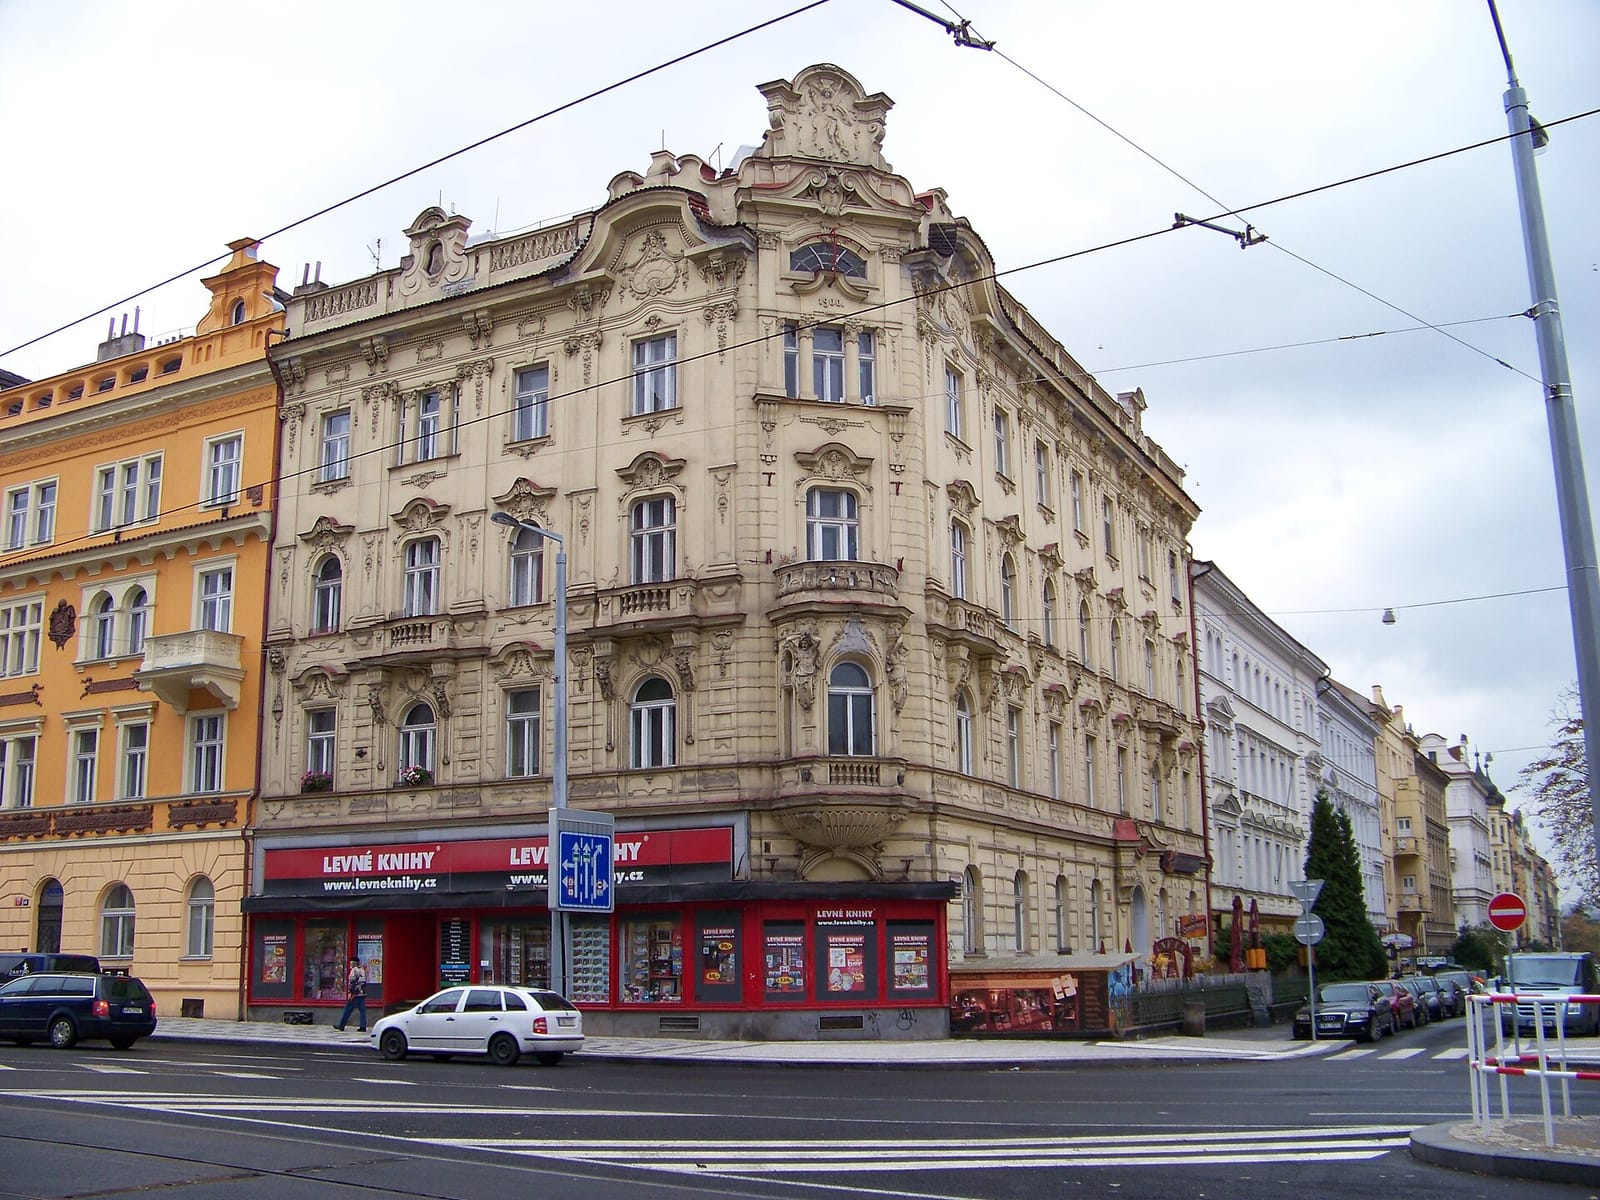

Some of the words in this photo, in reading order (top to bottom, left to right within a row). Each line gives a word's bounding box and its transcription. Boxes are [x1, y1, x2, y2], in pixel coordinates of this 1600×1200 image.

[323, 850, 373, 873] LEVNÉ
[377, 851, 435, 871] KNIHY
[323, 875, 437, 891] www.levneknihy.cz
[817, 908, 844, 918] LEVNÉ
[845, 910, 873, 918] KNIHY
